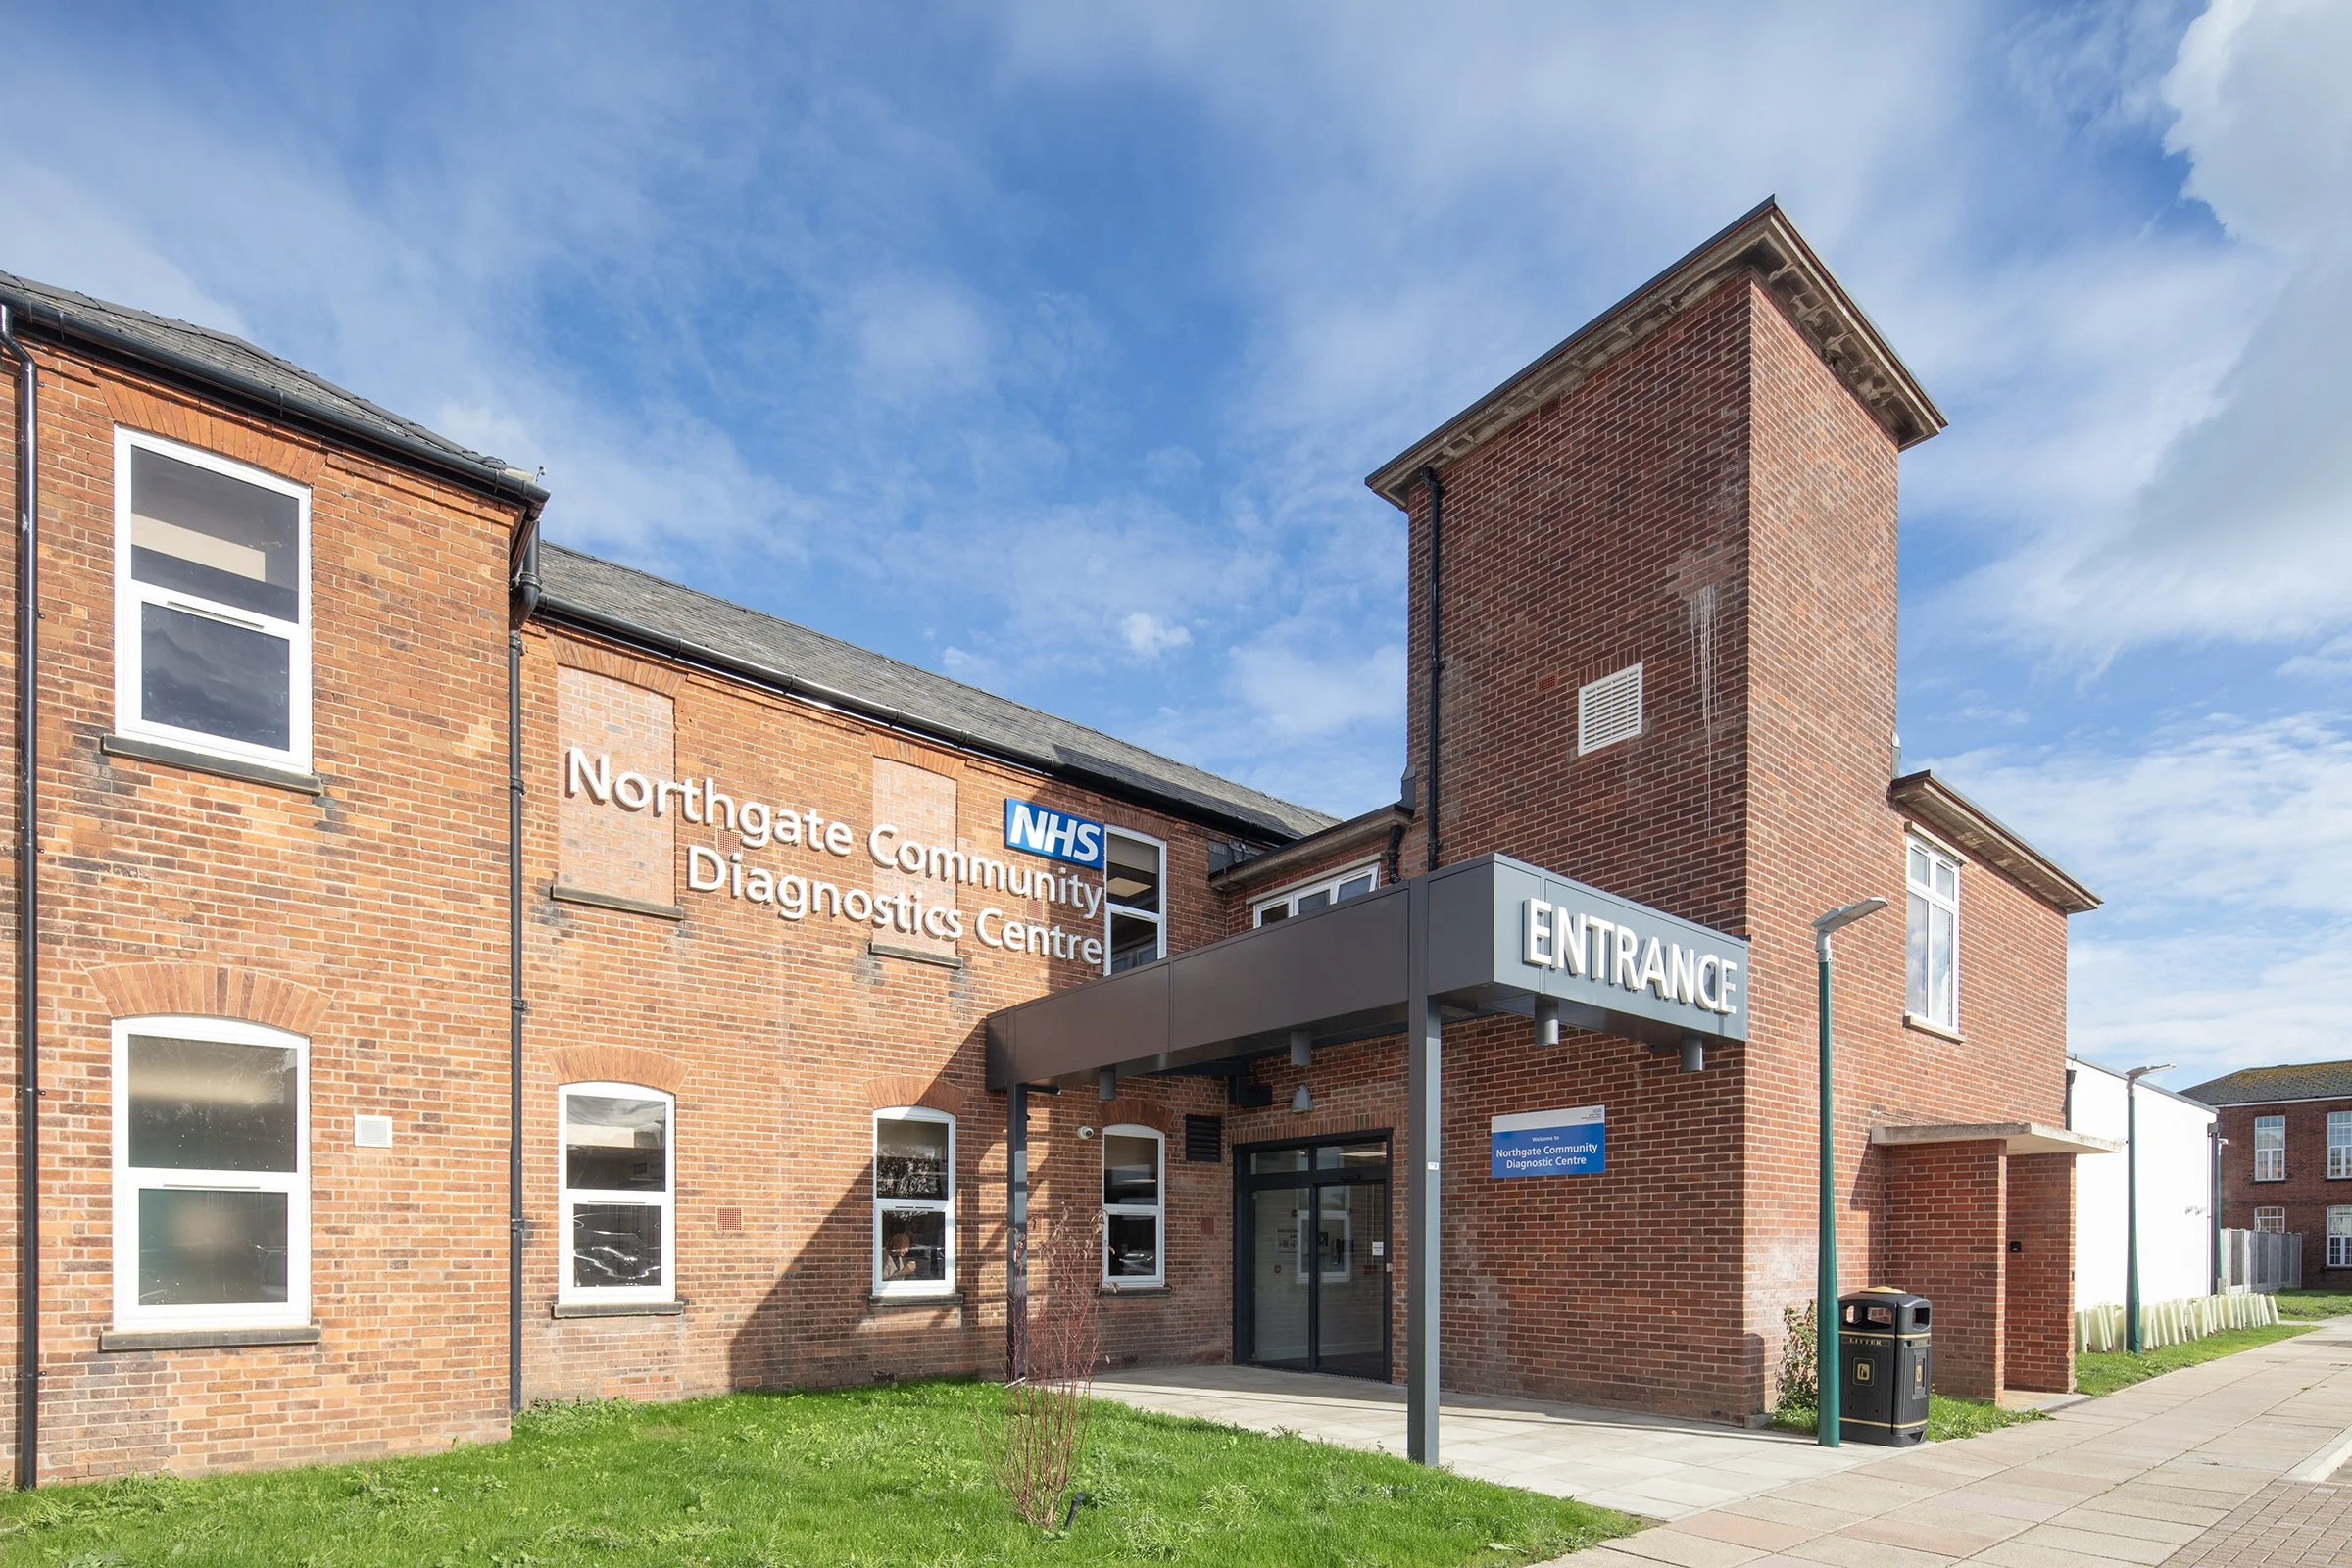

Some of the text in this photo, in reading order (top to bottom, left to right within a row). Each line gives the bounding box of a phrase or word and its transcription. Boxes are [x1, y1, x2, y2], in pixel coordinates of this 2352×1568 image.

[568, 746, 1103, 919] Northgate Community
[1008, 802, 1101, 862] NHS
[687, 844, 1102, 965] Diagnostics Centre
[1523, 897, 1738, 1015] ENTRANCE
[1495, 1142, 1598, 1158] Northgate Community
[1506, 1156, 1587, 1170] Diagnostic Centre
